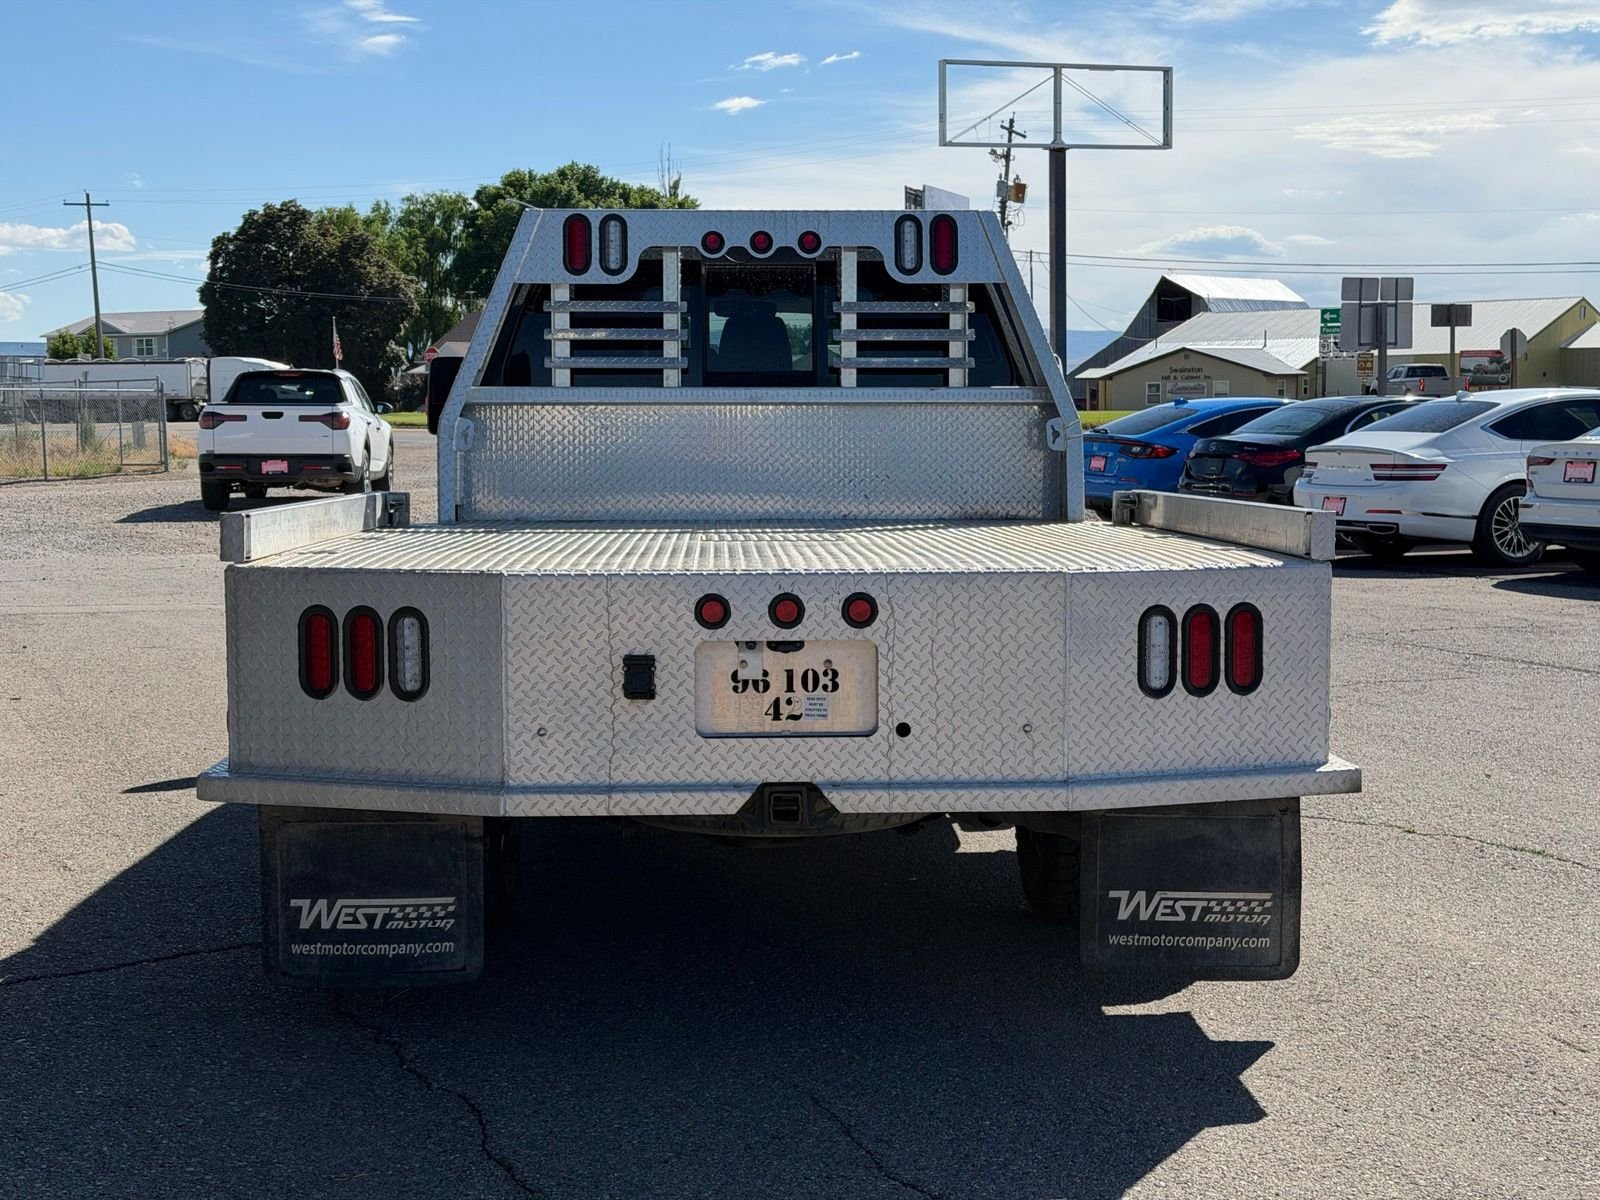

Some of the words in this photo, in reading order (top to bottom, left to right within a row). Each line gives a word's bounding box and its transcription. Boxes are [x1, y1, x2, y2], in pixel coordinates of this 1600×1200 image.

[1169, 366, 1203, 374] Swainston
[731, 669, 770, 693] 96
[784, 668, 840, 693] 103
[764, 696, 803, 721] 42
[290, 898, 391, 929] WEST
[386, 918, 456, 932] MOTOR
[1109, 890, 1208, 921] WEST
[1203, 914, 1272, 927] MOTOR
[291, 941, 455, 957] westmotorcompany.com
[1108, 933, 1270, 950] westmotorcompany.com
